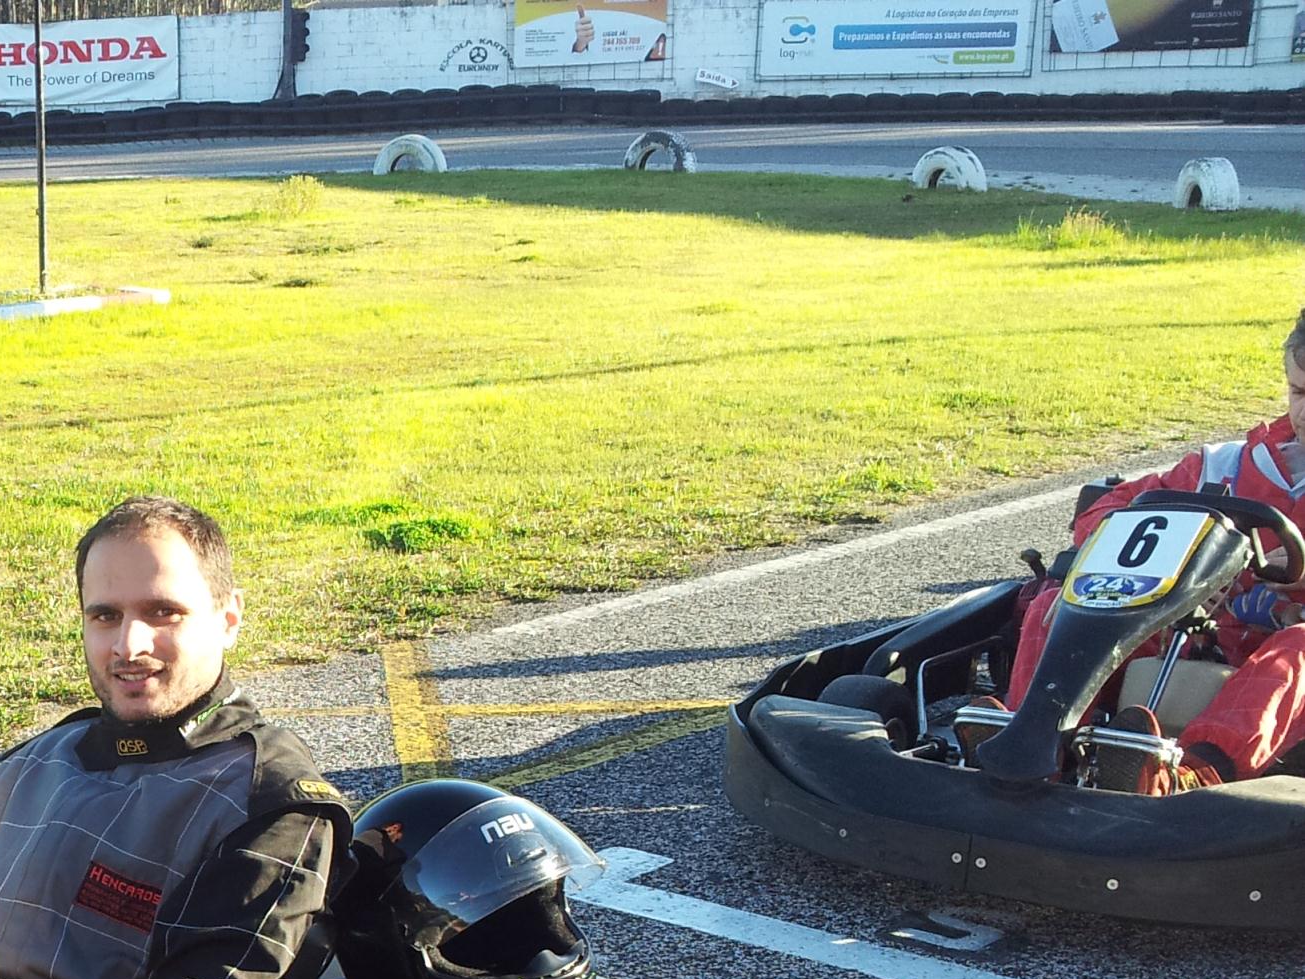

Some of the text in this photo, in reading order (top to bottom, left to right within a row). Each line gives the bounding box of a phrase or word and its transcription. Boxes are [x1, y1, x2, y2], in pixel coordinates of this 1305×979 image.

[839, 31, 884, 42] Preparamos
[892, 31, 933, 41] Expedimos
[944, 31, 961, 39] suas
[962, 29, 1010, 39] encomendas
[439, 39, 473, 72] ESCOLA
[458, 64, 499, 72] EUROINDY
[7, 71, 155, 87] The ower of Dreams
[1117, 515, 1169, 568] 6
[1089, 578, 1124, 592] 24
[480, 813, 535, 844] nau
